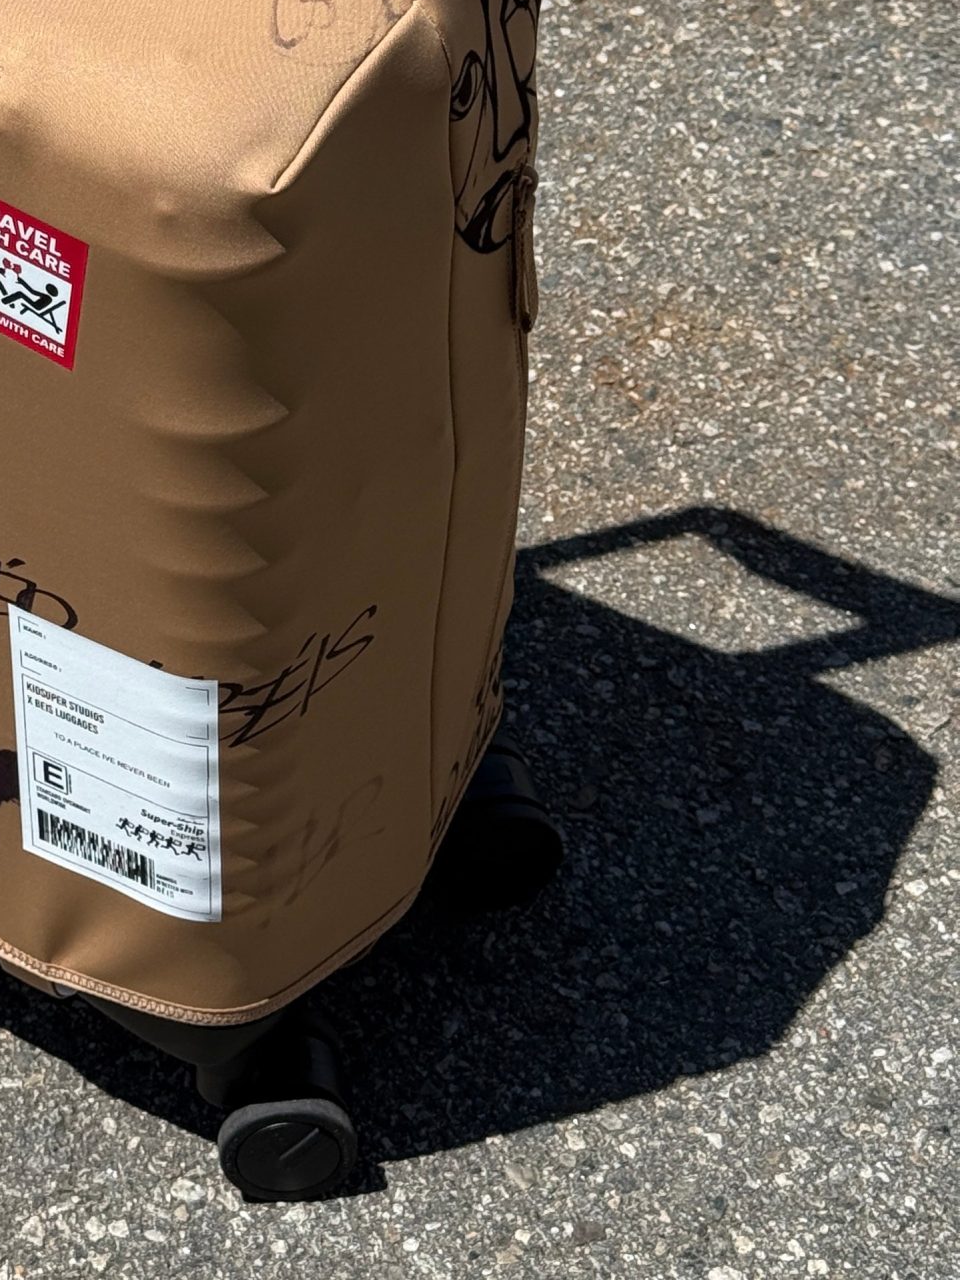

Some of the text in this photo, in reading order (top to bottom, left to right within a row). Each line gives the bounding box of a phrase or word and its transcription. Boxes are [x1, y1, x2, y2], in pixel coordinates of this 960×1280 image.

[15, 239, 71, 278] CARE
[32, 333, 64, 358] CARE
[26, 681, 105, 724] KIDSUPER STUDIOS
[27, 694, 33, 706] X
[55, 707, 99, 734] LUGGAGES
[54, 731, 66, 742] TO
[73, 740, 101, 758] PLACE
[43, 760, 64, 790] E
